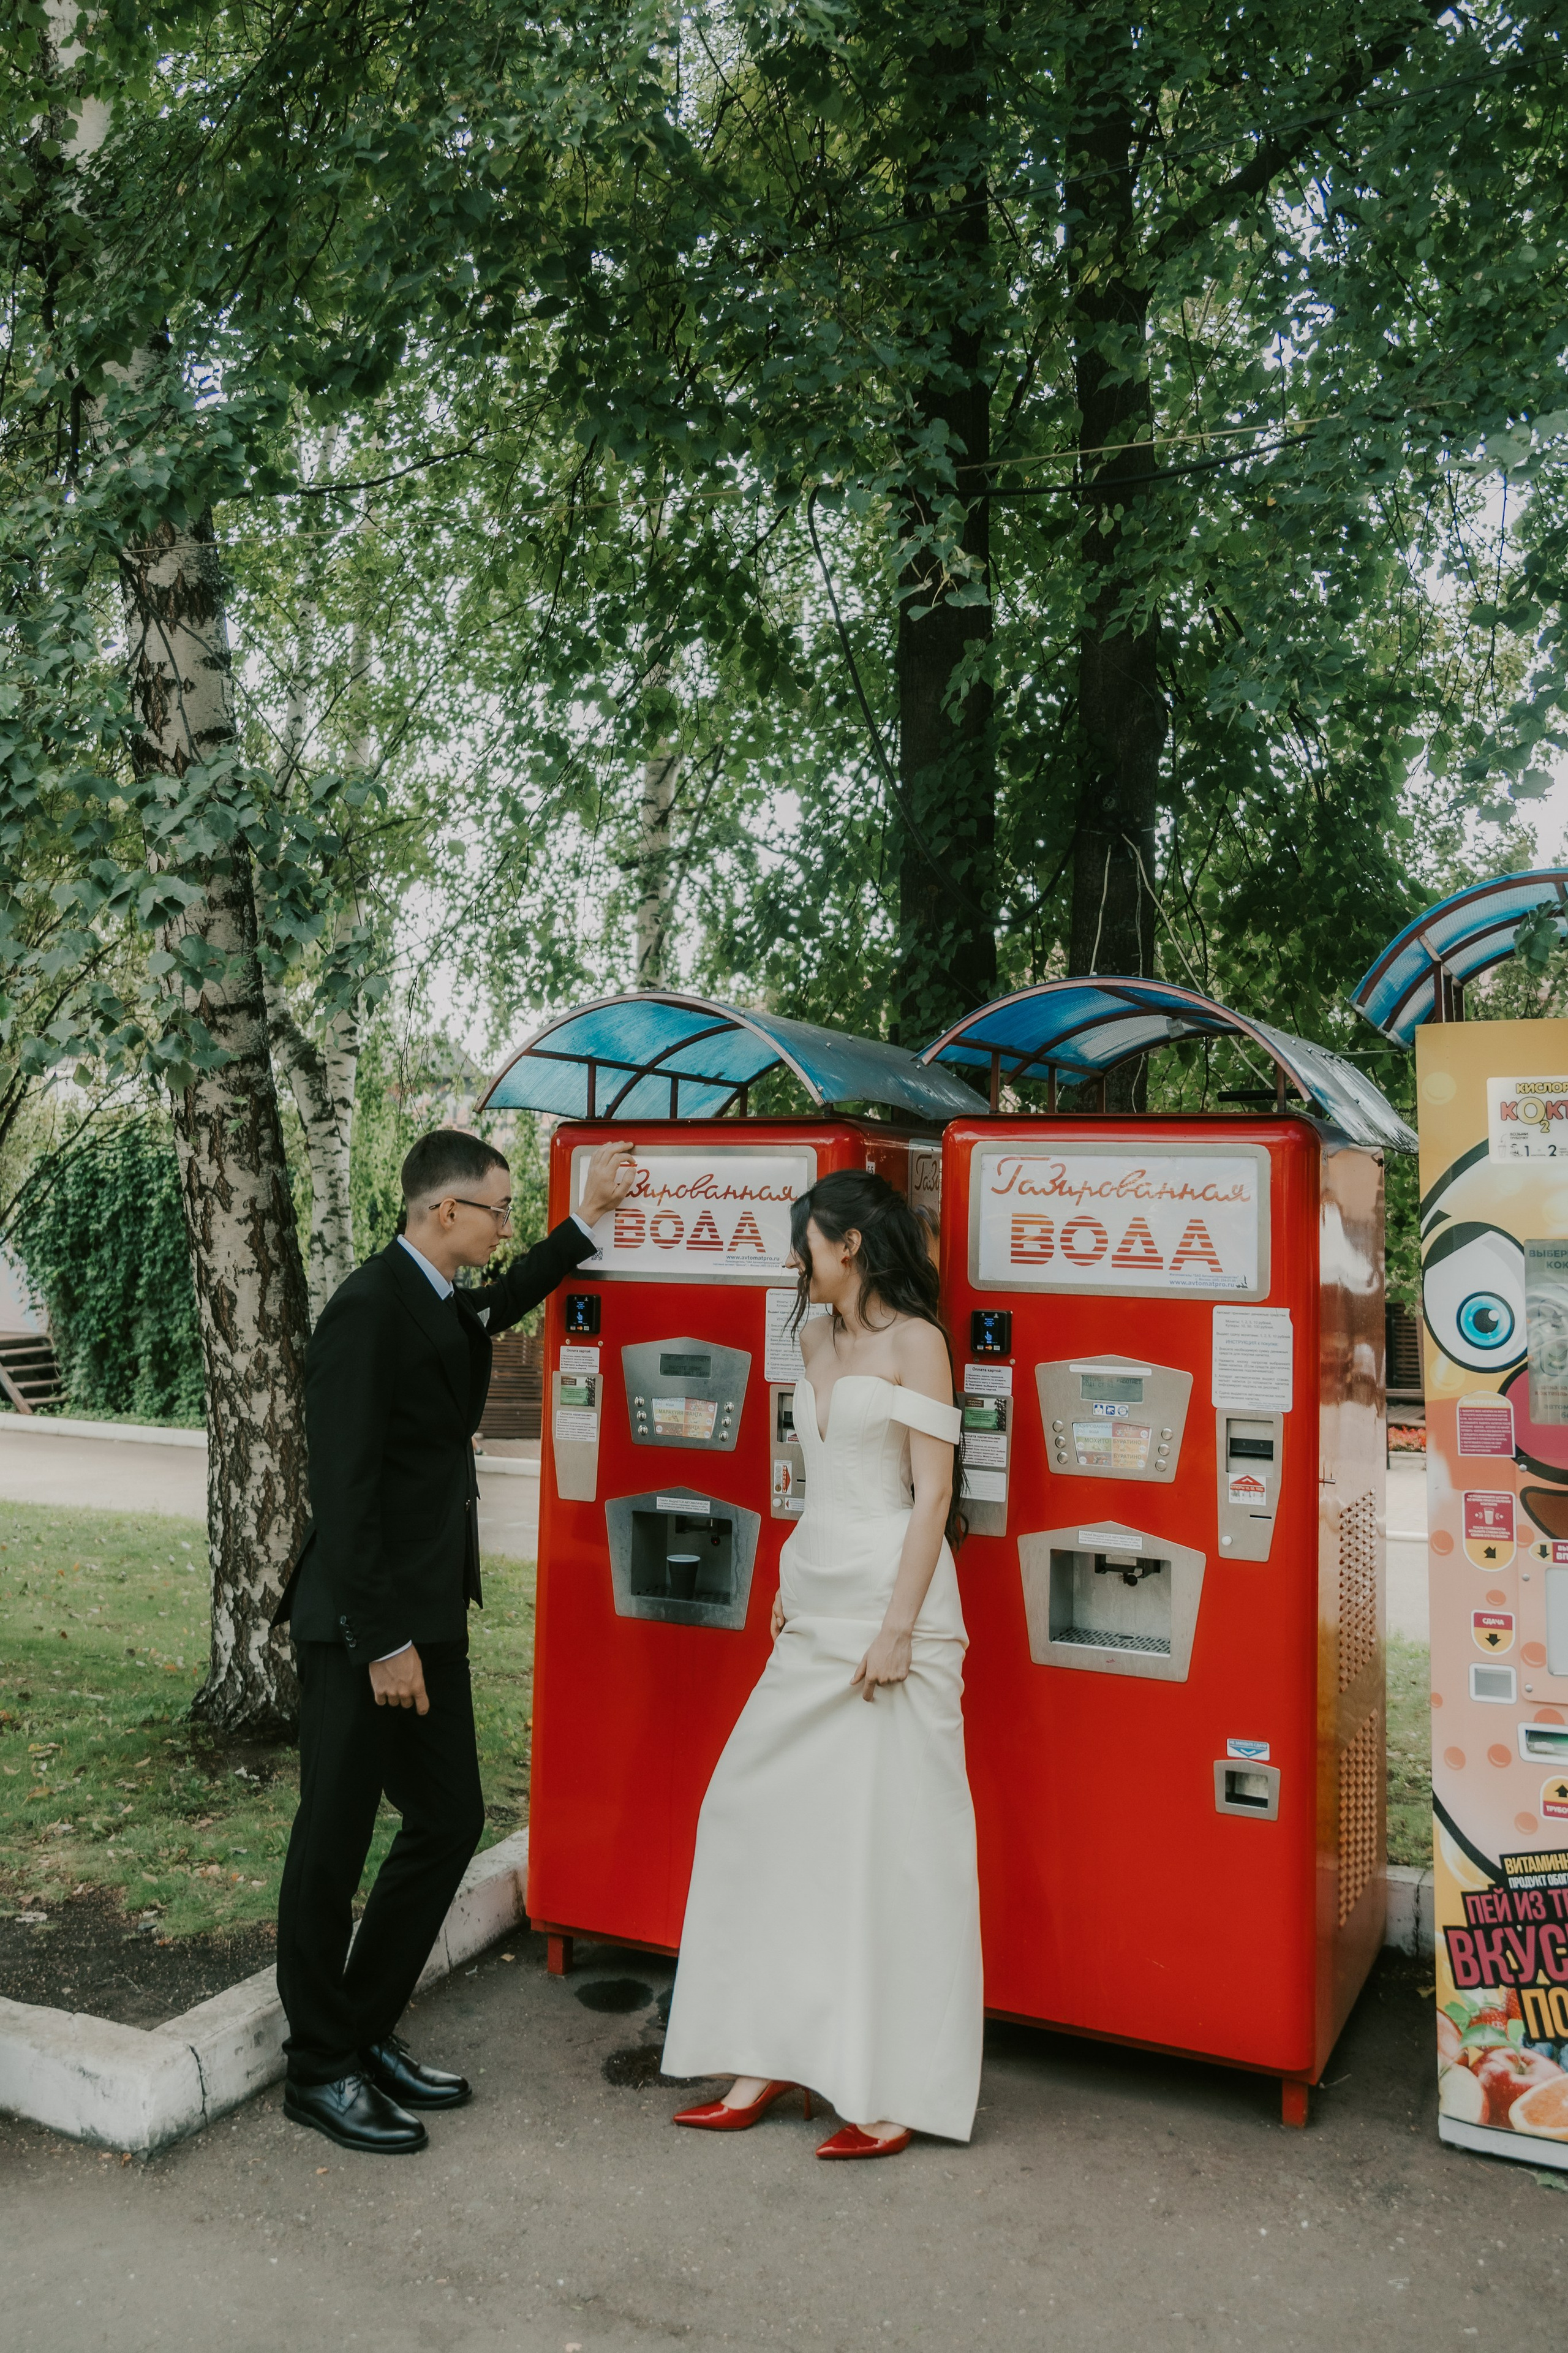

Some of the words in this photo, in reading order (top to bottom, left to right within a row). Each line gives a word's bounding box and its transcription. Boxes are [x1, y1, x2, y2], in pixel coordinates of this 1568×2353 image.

[1516, 1082, 1568, 1094] КИСЛОР
[1525, 1146, 1529, 1157] 1
[1548, 1144, 1557, 1157] 2
[616, 1164, 798, 1206] зированная
[990, 1156, 1251, 1206] Газированная
[614, 1208, 766, 1253] ВОДА
[1011, 1212, 1224, 1273] ВОДА
[1545, 1805, 1568, 1814] ТРУБО
[1504, 1853, 1568, 1875] ВИТАМИНН
[1508, 1875, 1547, 1889] ПРОДУКТ
[1548, 1873, 1568, 1886] ОБОГ
[1466, 1887, 1512, 1925] ПЕЙ
[1513, 1890, 1547, 1921] ИЗ
[1447, 1923, 1568, 1987] ВКУС
[1521, 1987, 1568, 2039] ПО
